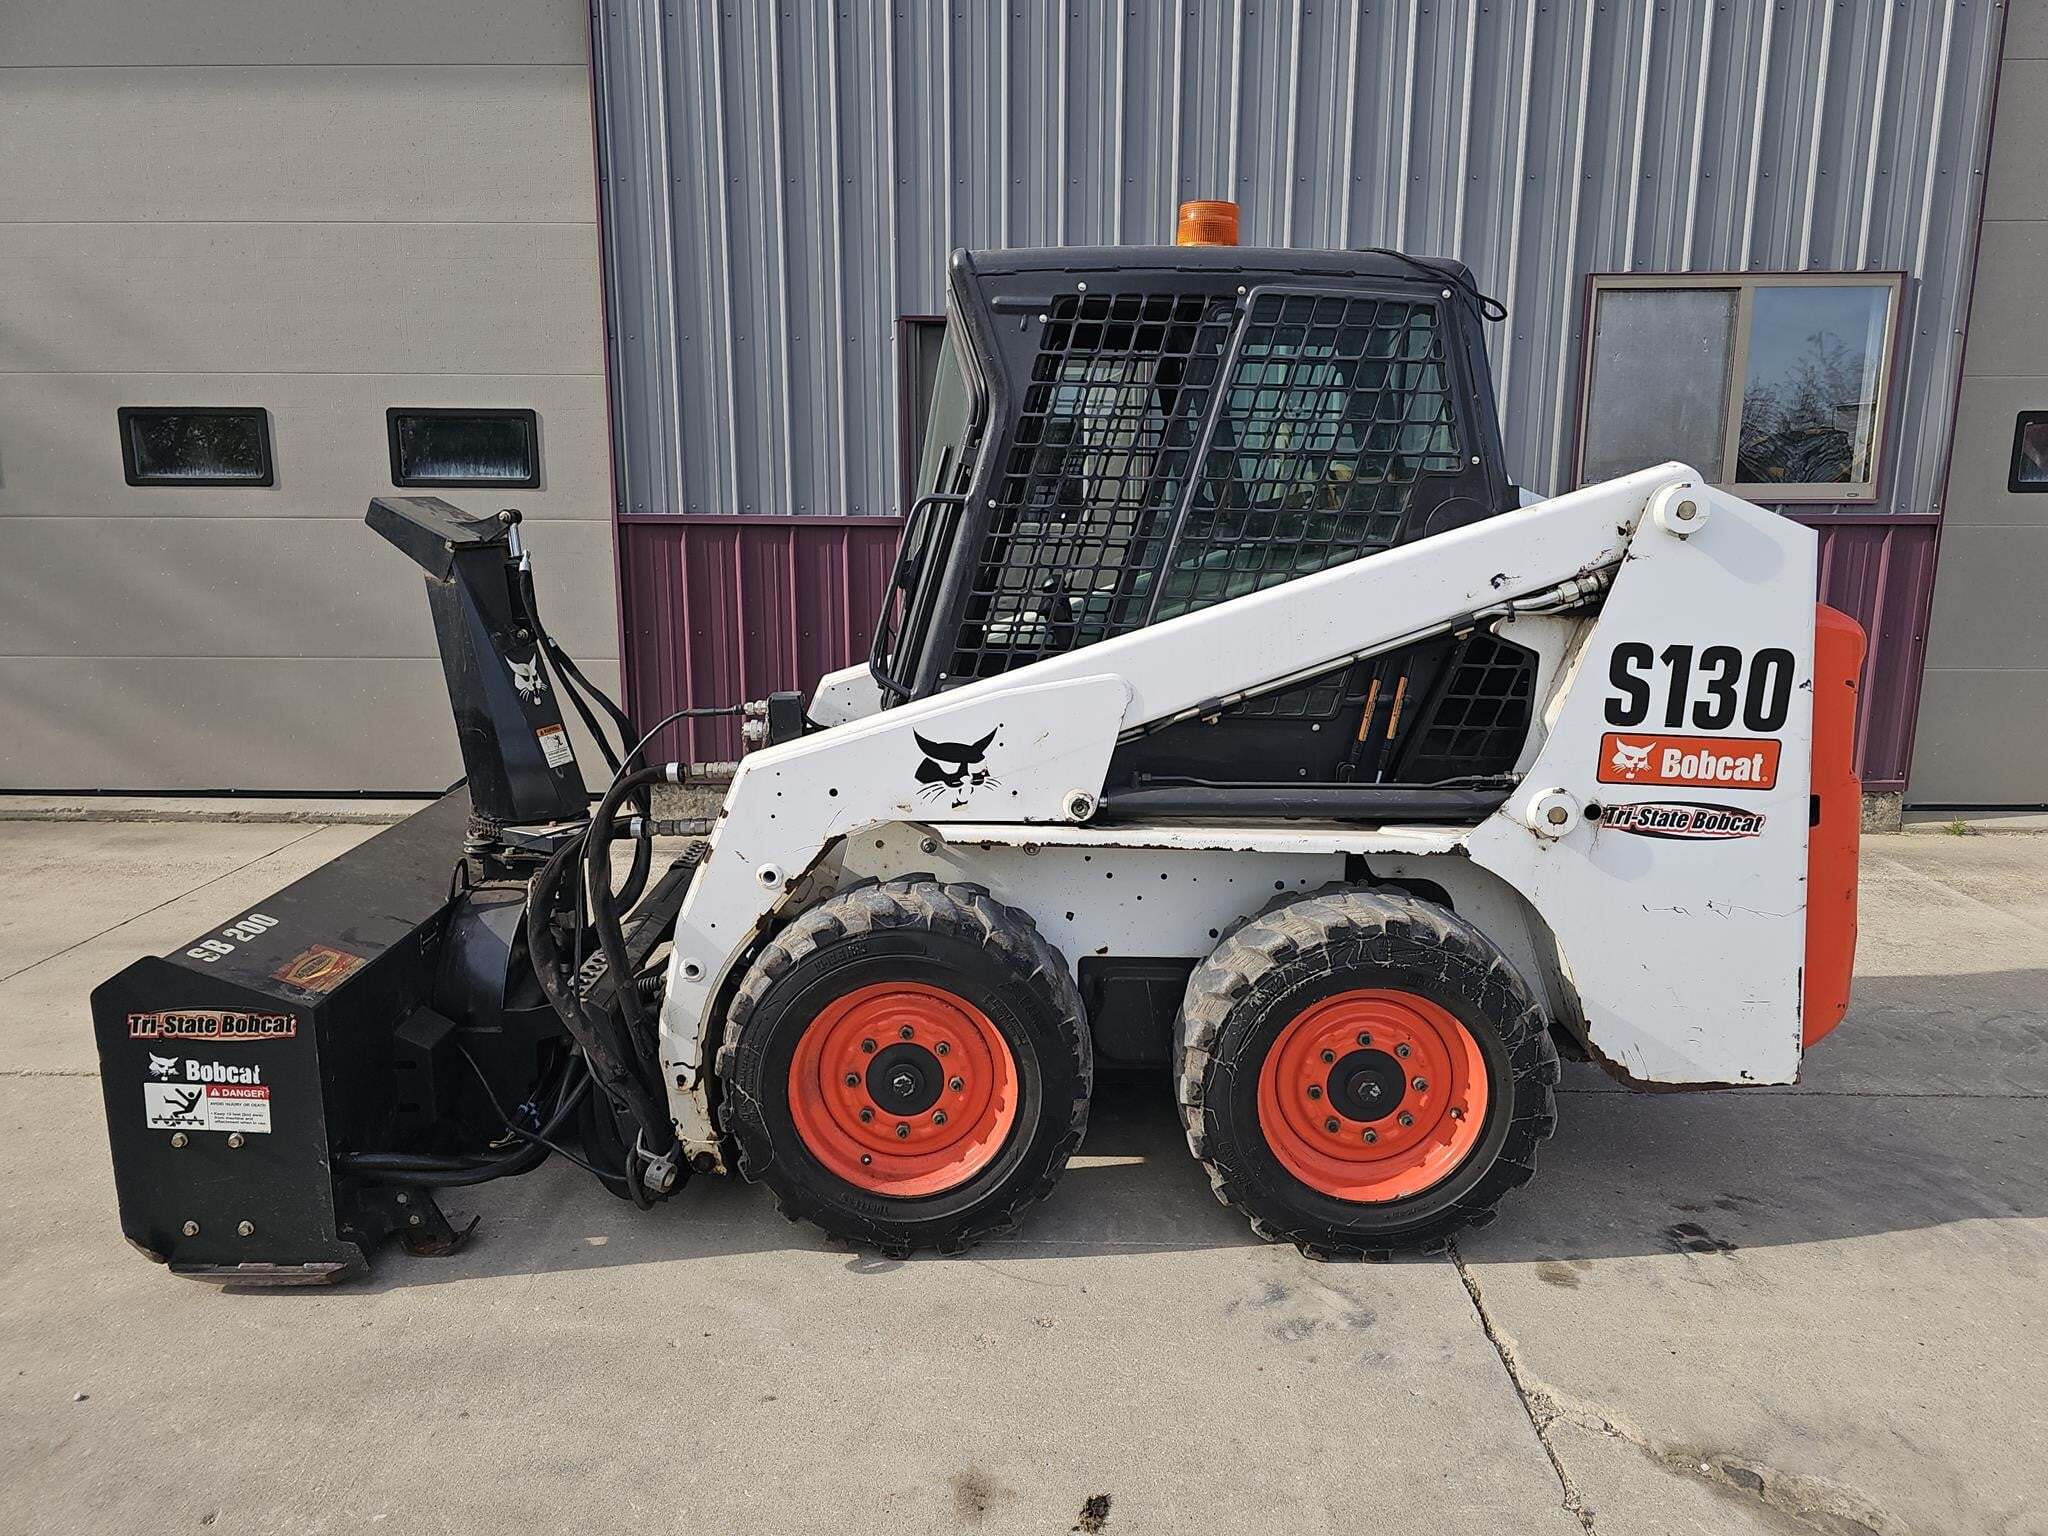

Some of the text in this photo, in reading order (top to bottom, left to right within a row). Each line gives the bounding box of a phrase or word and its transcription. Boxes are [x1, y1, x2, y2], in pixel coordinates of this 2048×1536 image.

[1604, 642, 1796, 733] S130
[1660, 748, 1764, 782] Bobcat
[1606, 806, 1764, 833] Tri-State Bobcat
[186, 913, 280, 963] SB 200
[130, 1014, 295, 1034] Tri-State Bobcat
[185, 1060, 262, 1085] Bobcat
[222, 1089, 265, 1098] DANGER
